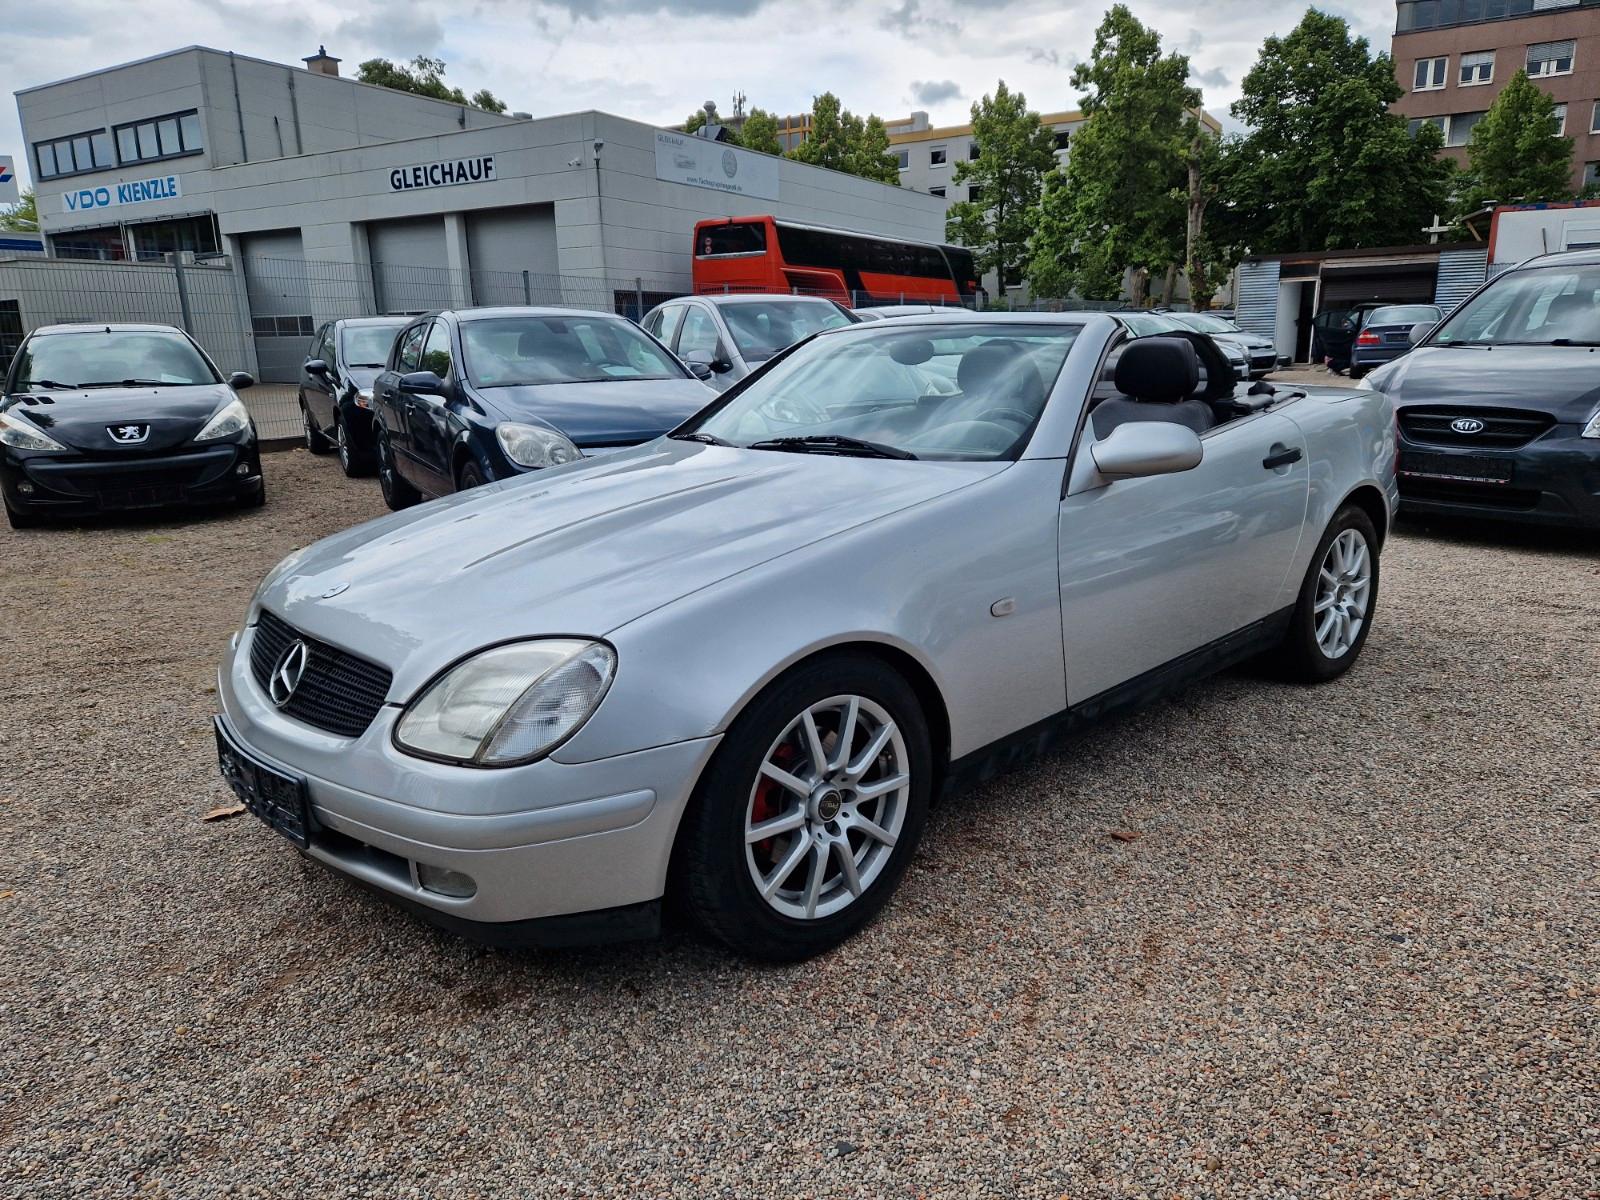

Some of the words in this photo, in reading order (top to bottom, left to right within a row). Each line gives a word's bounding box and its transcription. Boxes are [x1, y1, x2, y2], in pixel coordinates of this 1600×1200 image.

[390, 157, 493, 190] GLEICHAUF
[65, 187, 111, 210] VDO
[118, 176, 177, 204] KIENZLE
[1456, 421, 1477, 430] KIA
